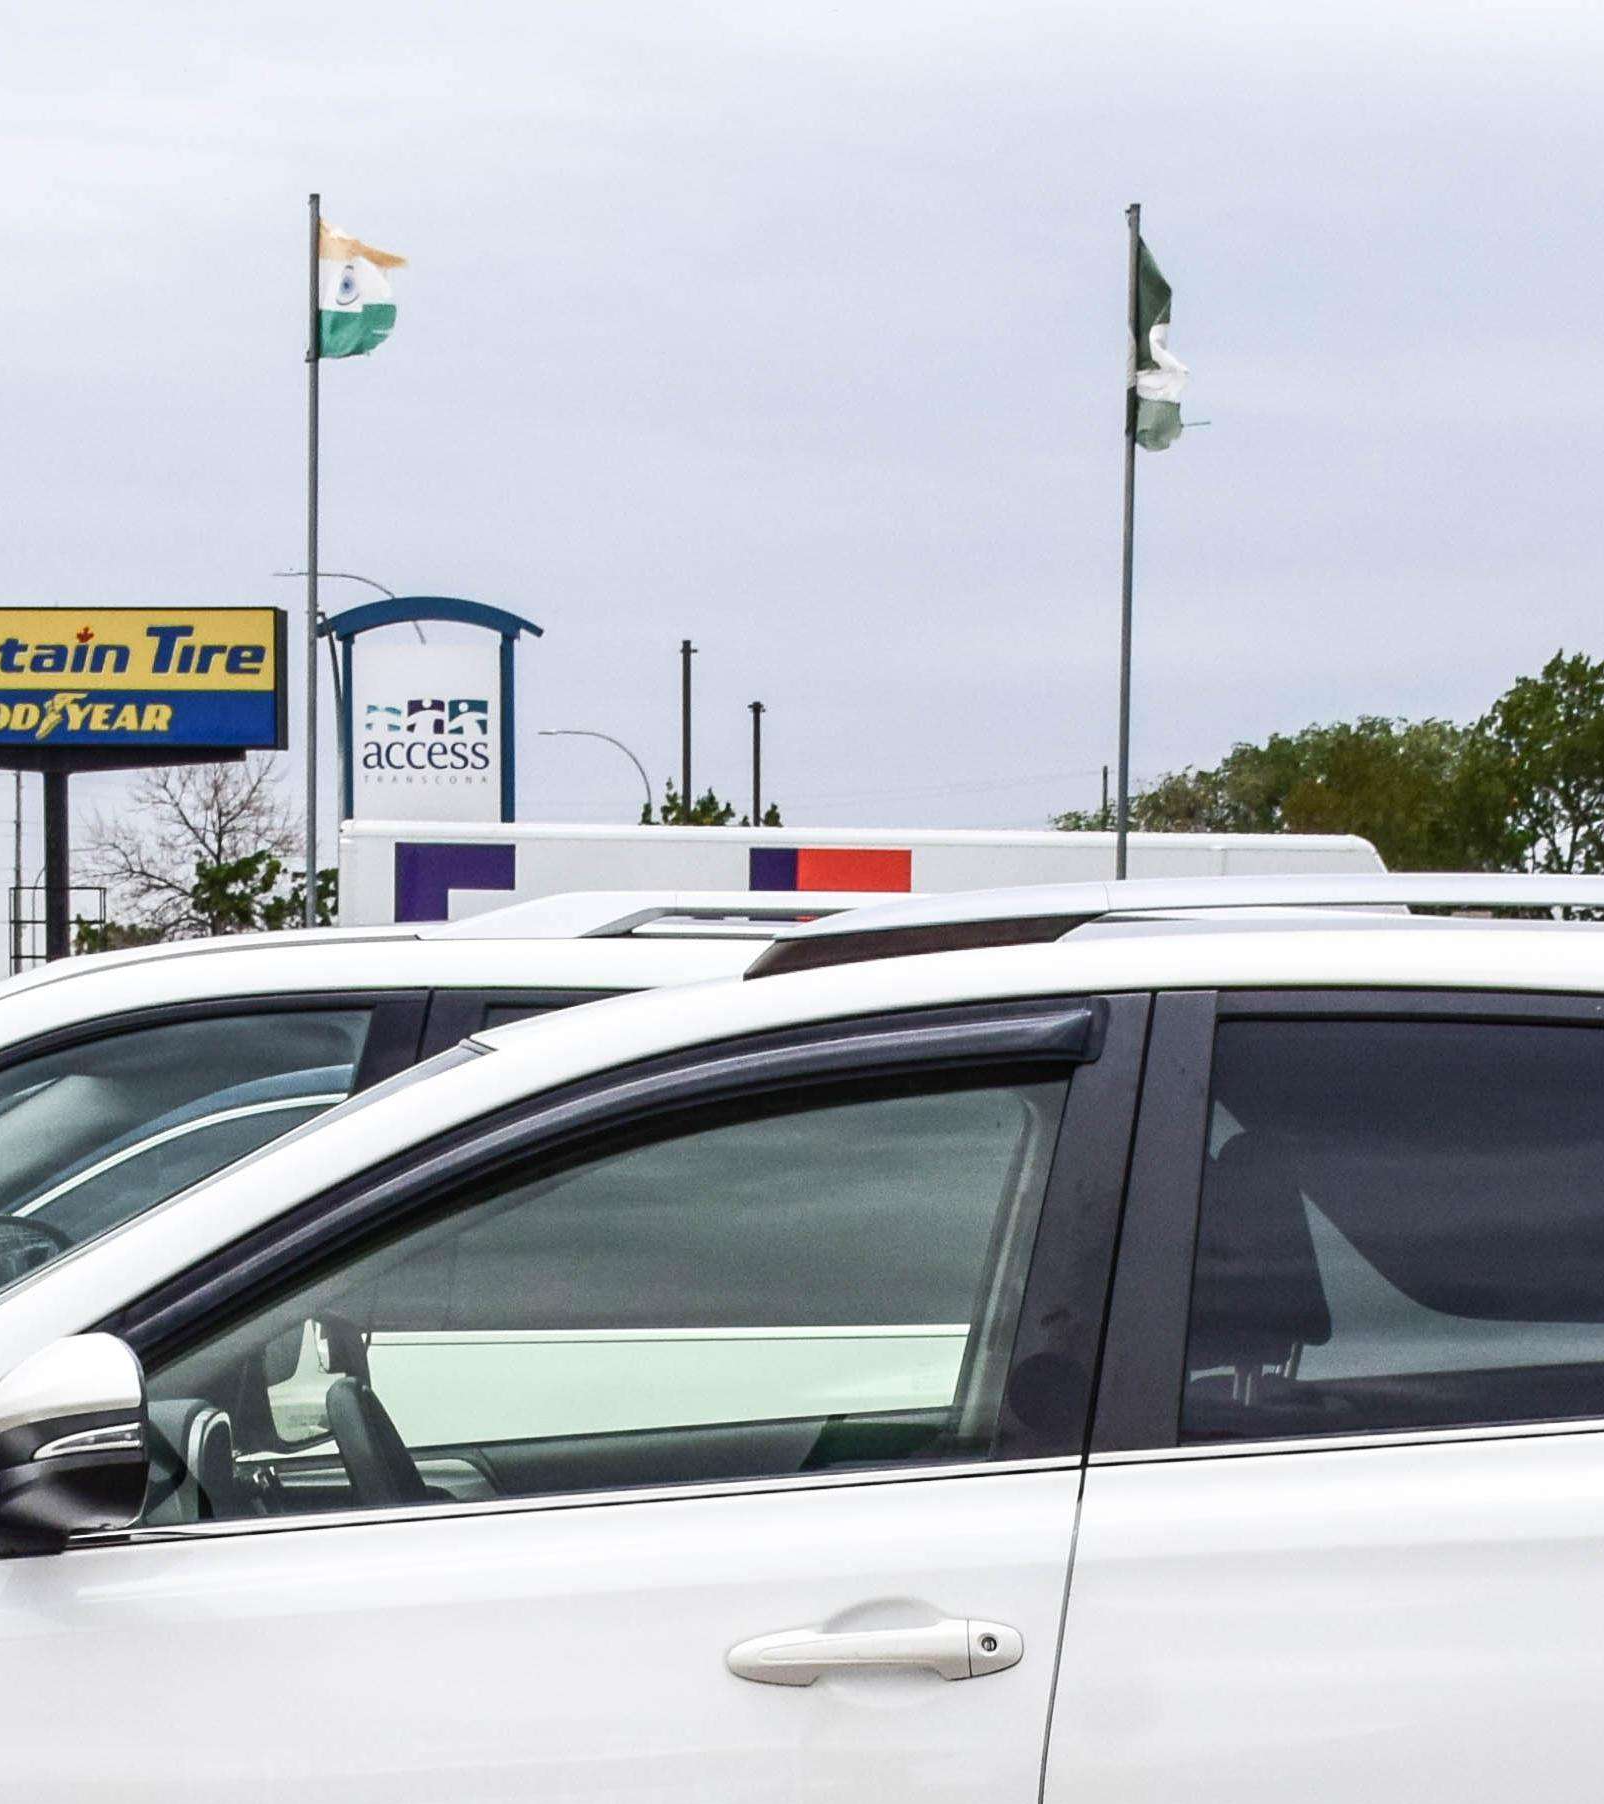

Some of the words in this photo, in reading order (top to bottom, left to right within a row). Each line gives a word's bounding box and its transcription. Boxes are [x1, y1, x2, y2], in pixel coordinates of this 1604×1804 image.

[145, 624, 267, 675] Tire
[362, 741, 490, 770] access
[363, 775, 489, 785] TRANSCONA
